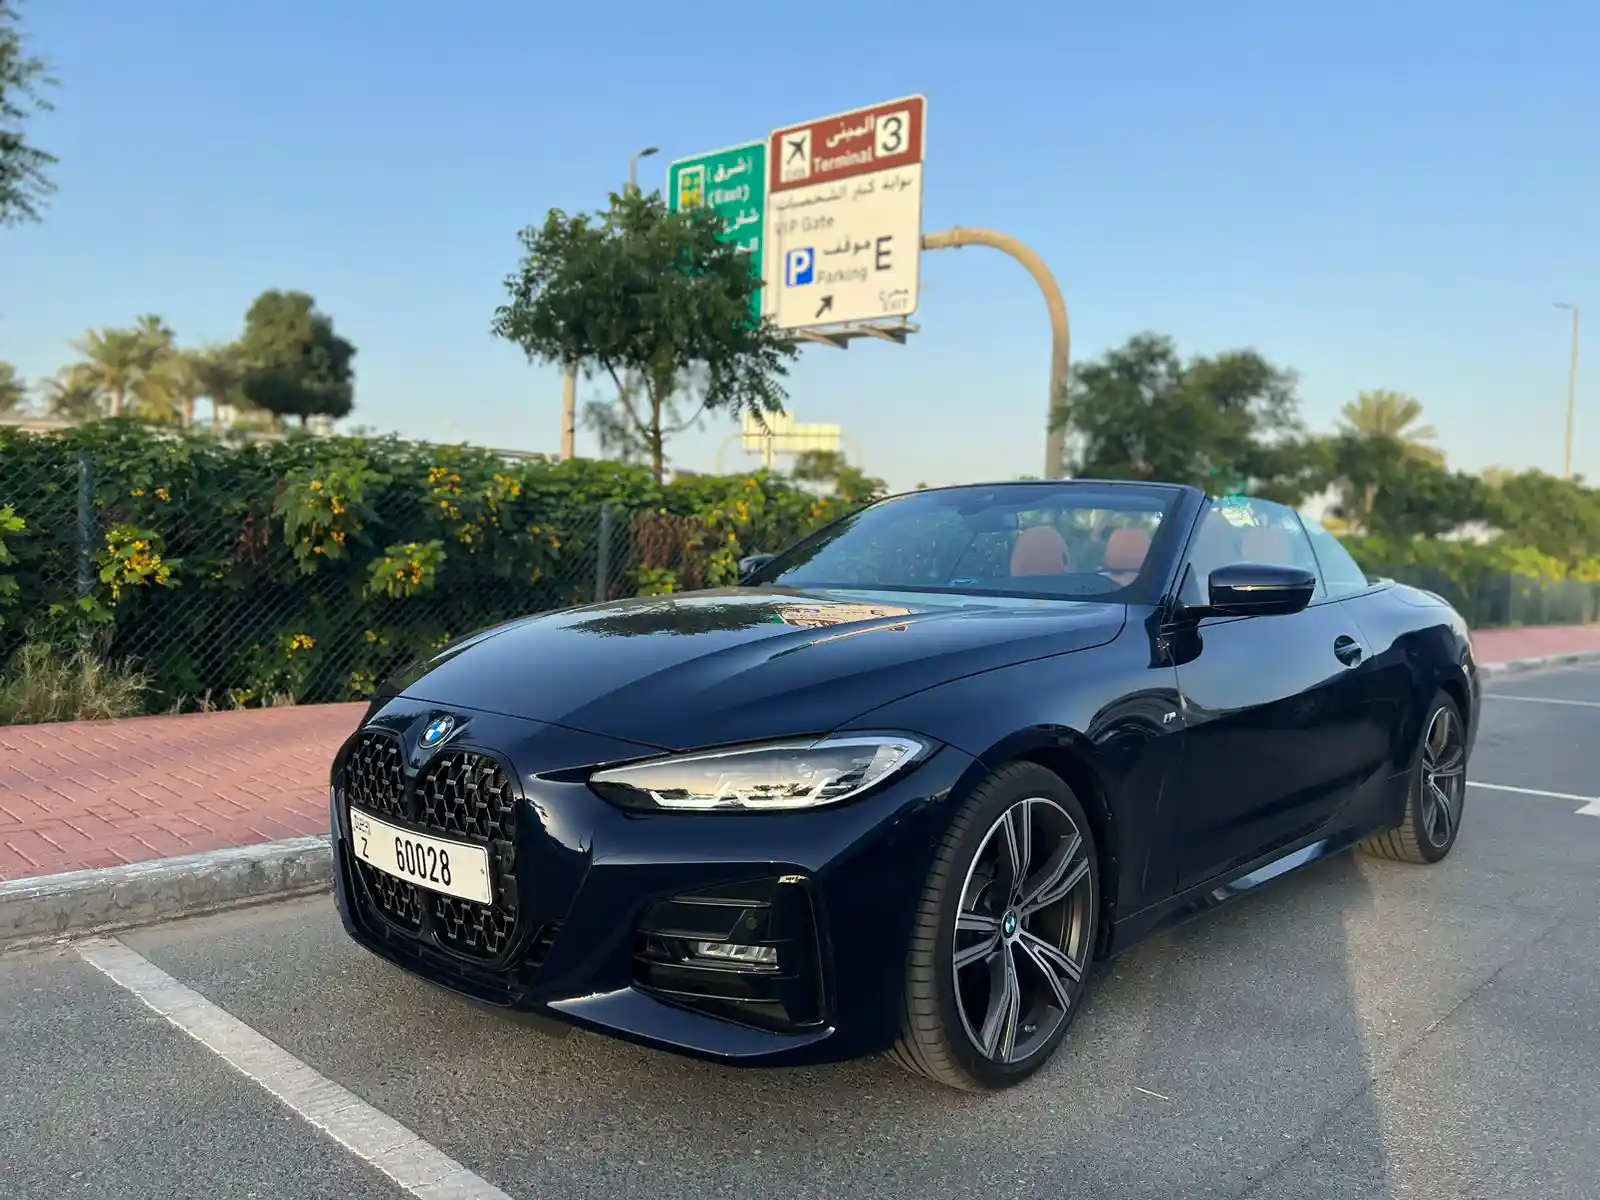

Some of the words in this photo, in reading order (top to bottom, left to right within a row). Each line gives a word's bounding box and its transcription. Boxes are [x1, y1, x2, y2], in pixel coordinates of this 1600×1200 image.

[881, 116, 903, 152] 3
[813, 145, 874, 174] Terminal
[774, 219, 799, 236] VIP
[801, 214, 835, 232] Gate
[789, 250, 811, 286] P
[875, 234, 894, 271] E
[816, 266, 869, 286] Parking
[361, 836, 370, 860] Z
[395, 836, 452, 887] 60028
